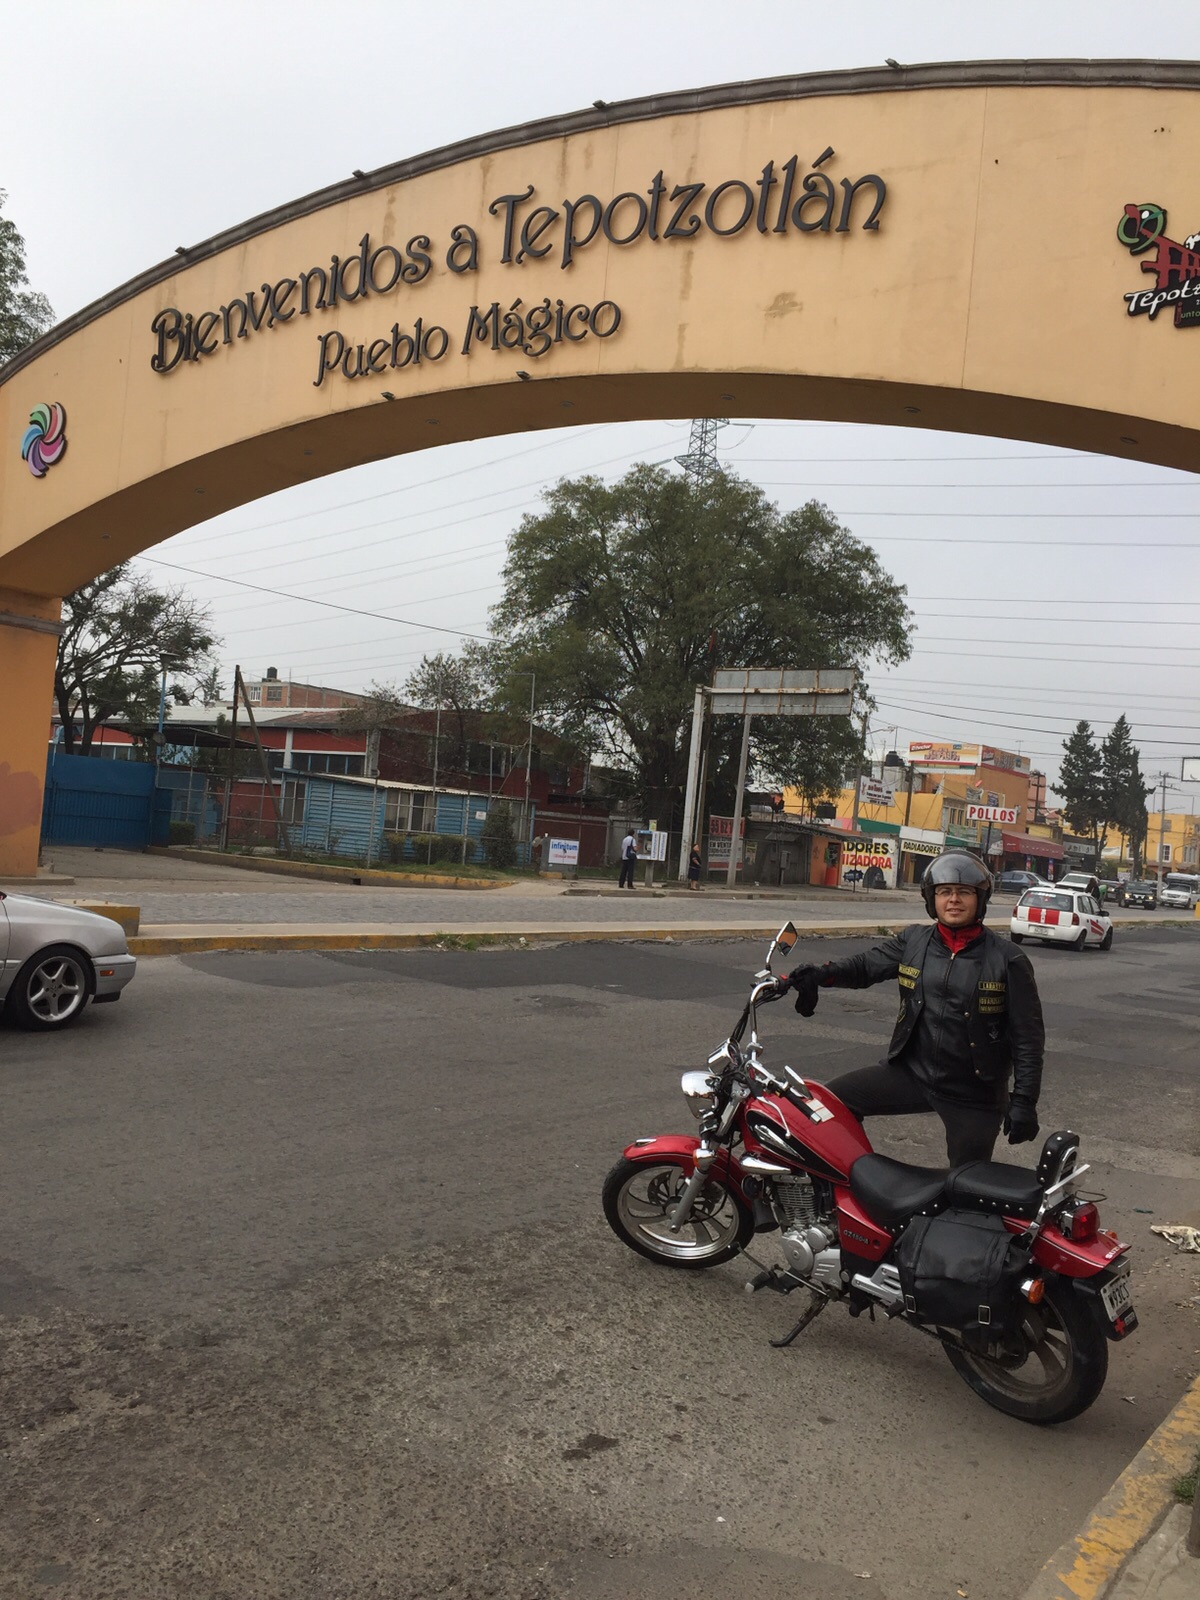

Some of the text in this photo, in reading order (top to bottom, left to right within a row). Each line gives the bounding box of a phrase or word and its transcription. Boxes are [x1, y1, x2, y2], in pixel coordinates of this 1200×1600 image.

[150, 146, 887, 373] Bienvenidos a Tepotzotlán
[313, 297, 622, 387] Pueblo Mágico
[969, 806, 1015, 822] POLLOS
[551, 841, 577, 851] infinitum
[843, 842, 889, 854] DORES
[903, 842, 941, 855] RADIADORES
